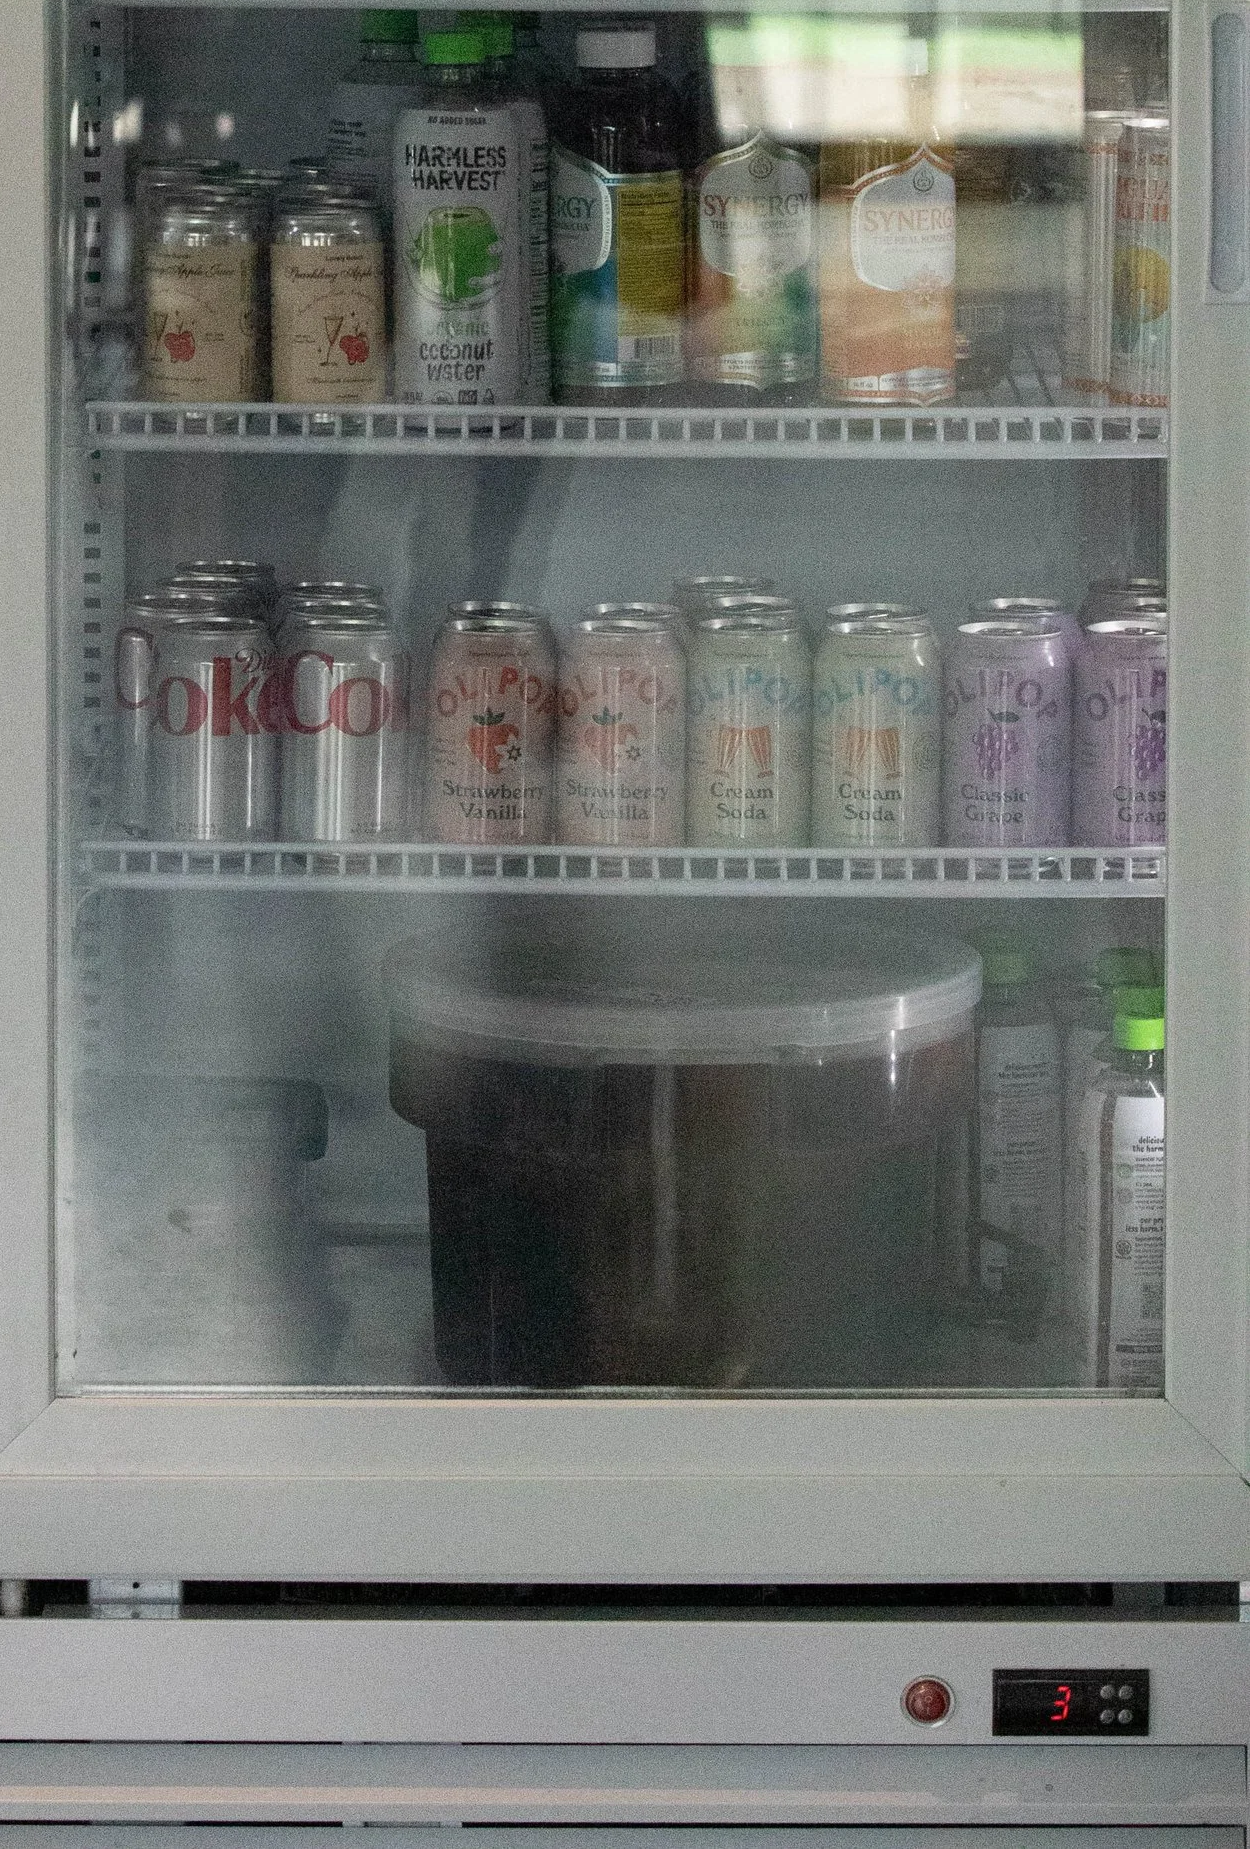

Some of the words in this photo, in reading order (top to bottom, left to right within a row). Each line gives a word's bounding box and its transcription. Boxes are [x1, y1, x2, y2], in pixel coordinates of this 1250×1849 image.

[406, 144, 507, 168] HARMLESS
[412, 169, 502, 191] HARVEST
[286, 266, 338, 284] Sparkling
[419, 339, 494, 361] coconut
[427, 361, 486, 381] water
[442, 779, 544, 801] Strawberry
[565, 779, 669, 801] Strawberry
[710, 782, 774, 800] Cream
[838, 783, 902, 801] Cream
[961, 784, 1028, 803] Classic
[459, 802, 528, 821] Vanilla
[580, 801, 652, 821] Vanilla
[716, 802, 768, 820] Soda
[844, 804, 896, 822] Soda
[964, 804, 1024, 824] Grape
[1050, 1685, 1071, 1721] 3
